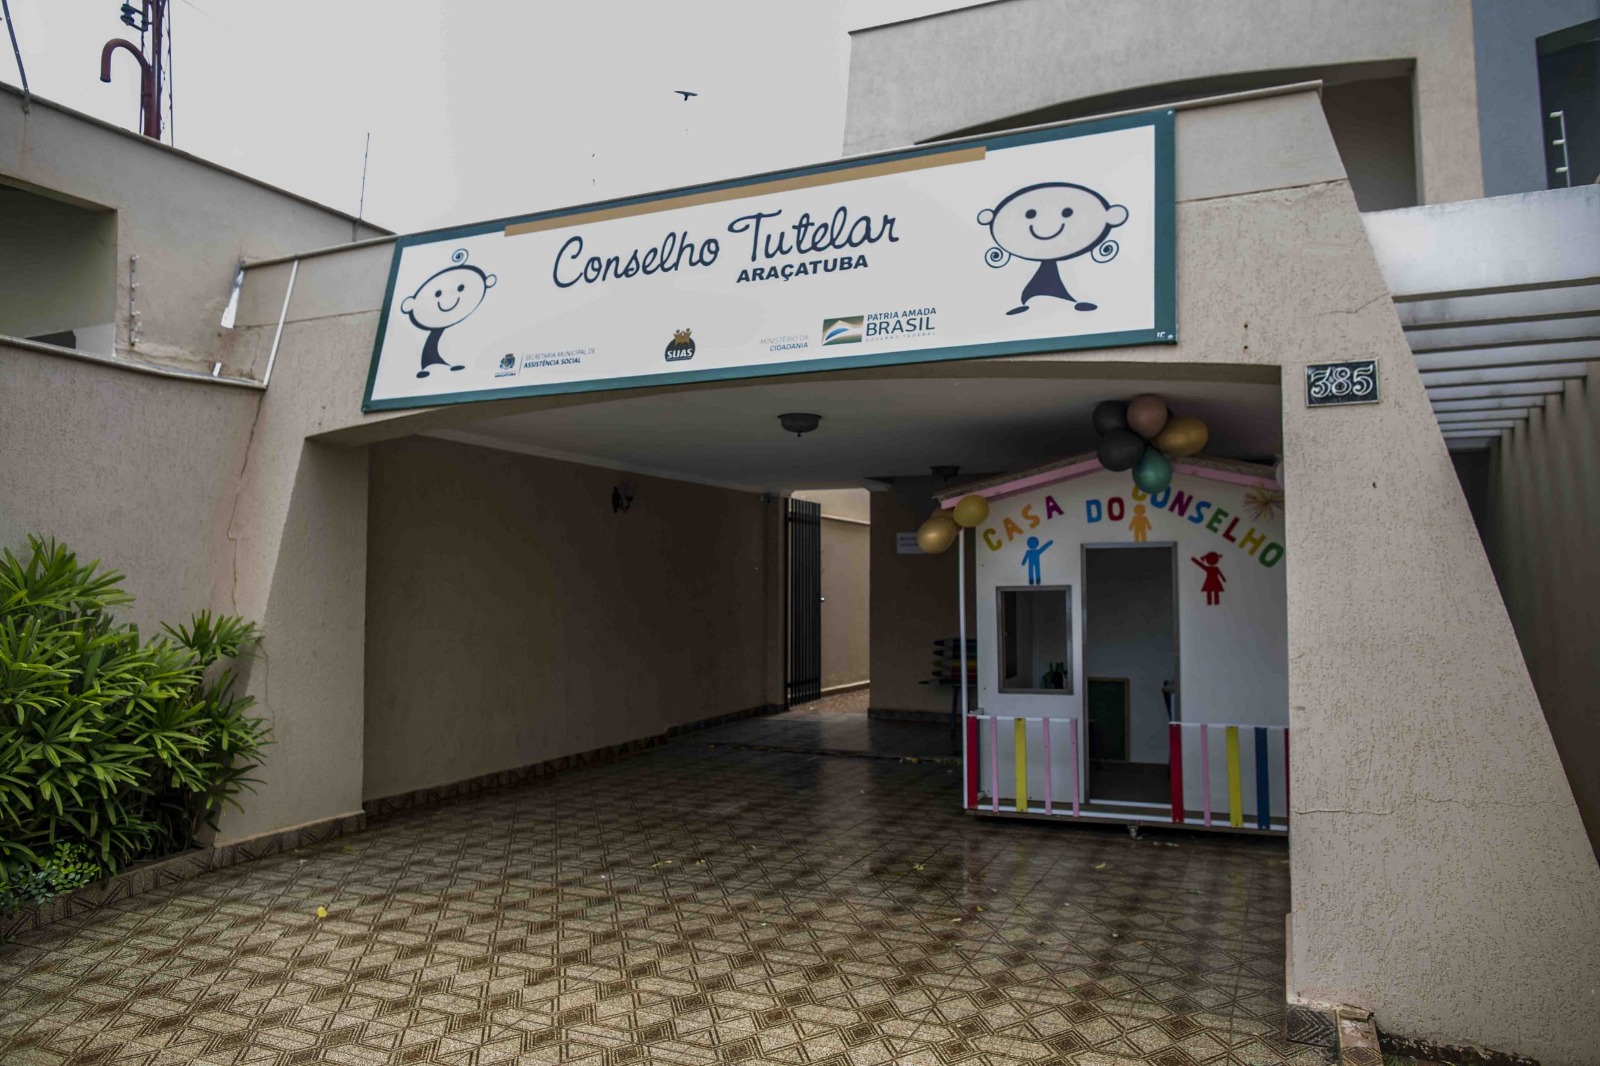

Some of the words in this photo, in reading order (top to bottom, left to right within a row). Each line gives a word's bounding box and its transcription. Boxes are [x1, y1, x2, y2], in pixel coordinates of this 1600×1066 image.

[553, 231, 720, 288] Conselho
[727, 206, 900, 263] Tutelar
[736, 254, 869, 284] ARAÇATUBA
[901, 307, 937, 318] AMADA
[866, 316, 935, 336] BRASIL
[666, 348, 693, 359] SUAS
[769, 342, 809, 351] CIDADANIA
[523, 358, 559, 368] ASSISTÊNCIA
[560, 357, 581, 366] SOCIAL
[1310, 364, 1374, 398] 385
[983, 495, 1064, 551] CASA
[1085, 497, 1125, 523] DO
